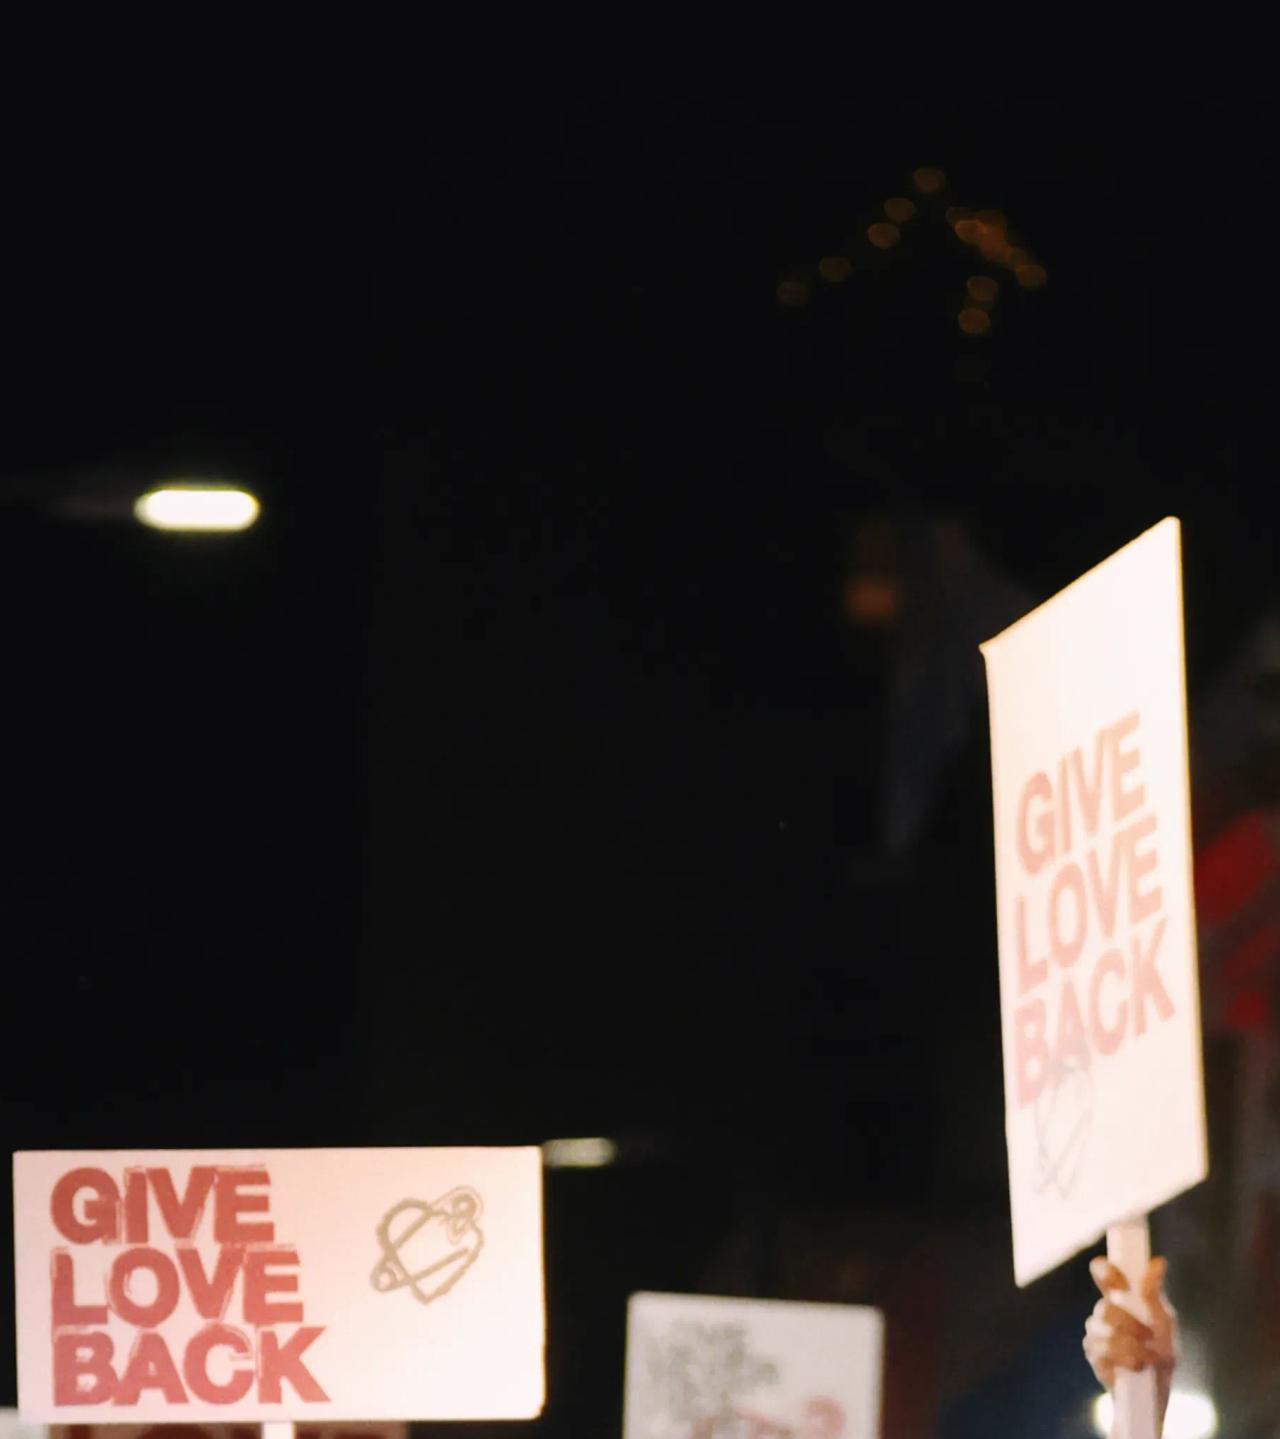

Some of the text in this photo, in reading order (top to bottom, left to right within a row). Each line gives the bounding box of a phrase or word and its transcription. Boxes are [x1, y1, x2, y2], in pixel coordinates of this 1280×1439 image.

[1018, 711, 1145, 876] GIVE
[1017, 813, 1163, 996] LOVE
[1014, 917, 1176, 1108] BACK
[50, 1164, 275, 1245] GIVE
[51, 1245, 305, 1328] LOVE
[51, 1324, 331, 1407] BACK
